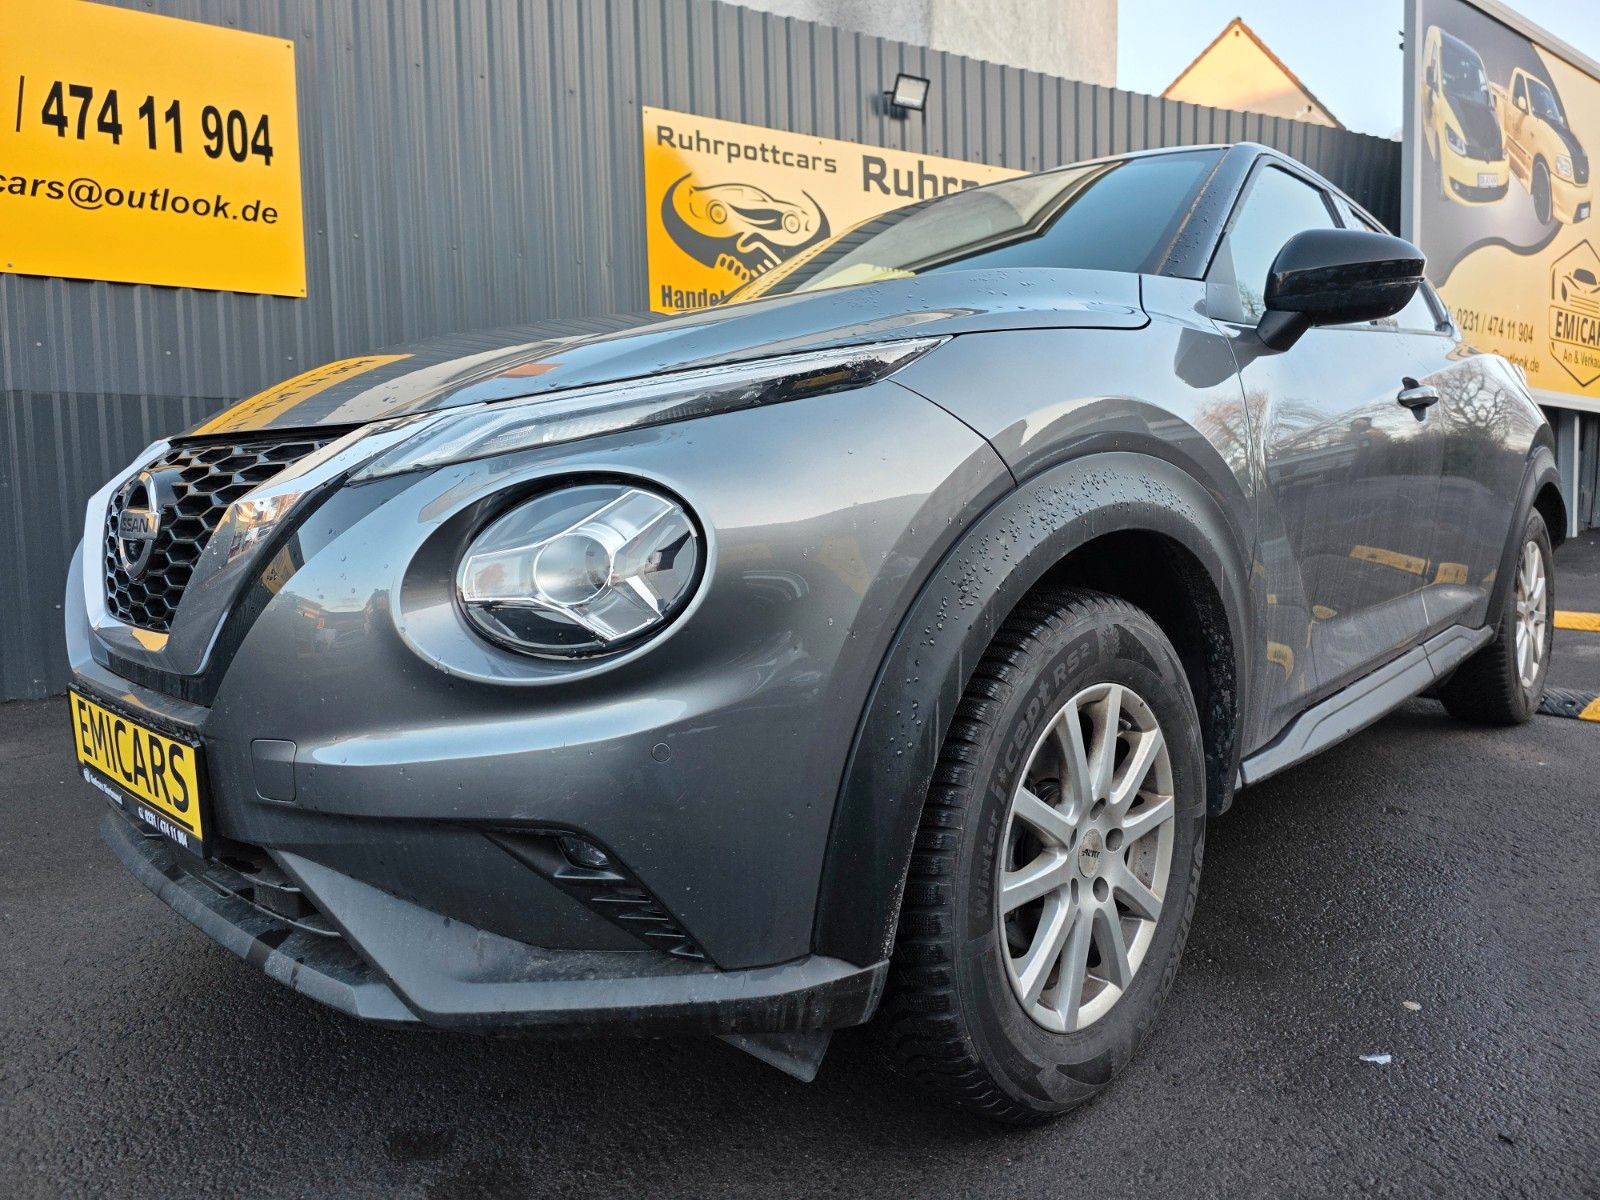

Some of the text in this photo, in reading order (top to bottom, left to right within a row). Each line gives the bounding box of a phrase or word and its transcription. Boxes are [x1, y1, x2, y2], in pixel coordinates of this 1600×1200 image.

[41, 80, 123, 145] 474
[138, 95, 183, 154] 11
[201, 104, 274, 166] 904
[656, 125, 837, 173] Ruhrpottcars
[1457, 308, 1479, 333] 0231
[1488, 315, 1504, 337] 474
[1507, 320, 1516, 340] 11
[1519, 321, 1534, 344] 904
[77, 699, 189, 813] EMICARS
